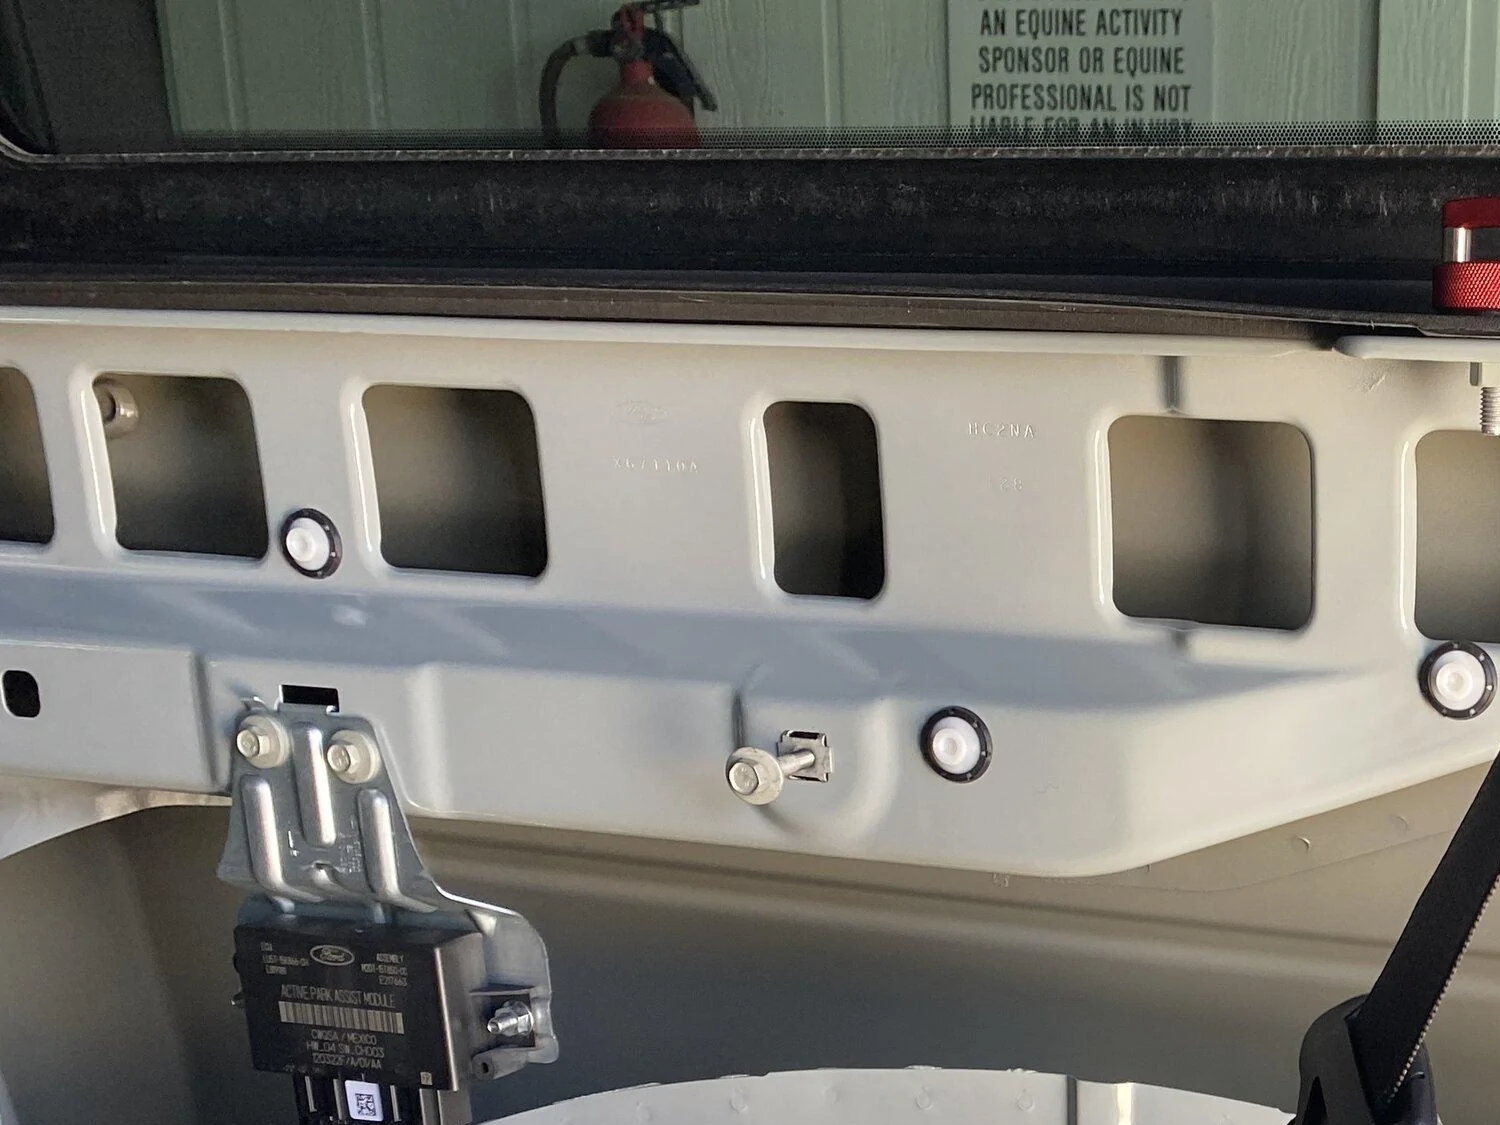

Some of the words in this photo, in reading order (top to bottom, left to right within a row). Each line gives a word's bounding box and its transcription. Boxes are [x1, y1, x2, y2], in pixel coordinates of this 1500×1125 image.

[980, 8, 1007, 37] AN
[1015, 8, 1087, 40] EQUINE
[1095, 8, 1184, 37] ACTIVITY
[978, 46, 1070, 74] SPONSOR
[1079, 46, 1104, 74] OR
[1113, 46, 1185, 78] EQUINE
[971, 83, 1118, 111] PROFESSIONAL
[1125, 83, 1144, 111] IS
[1153, 83, 1192, 112] NOT
